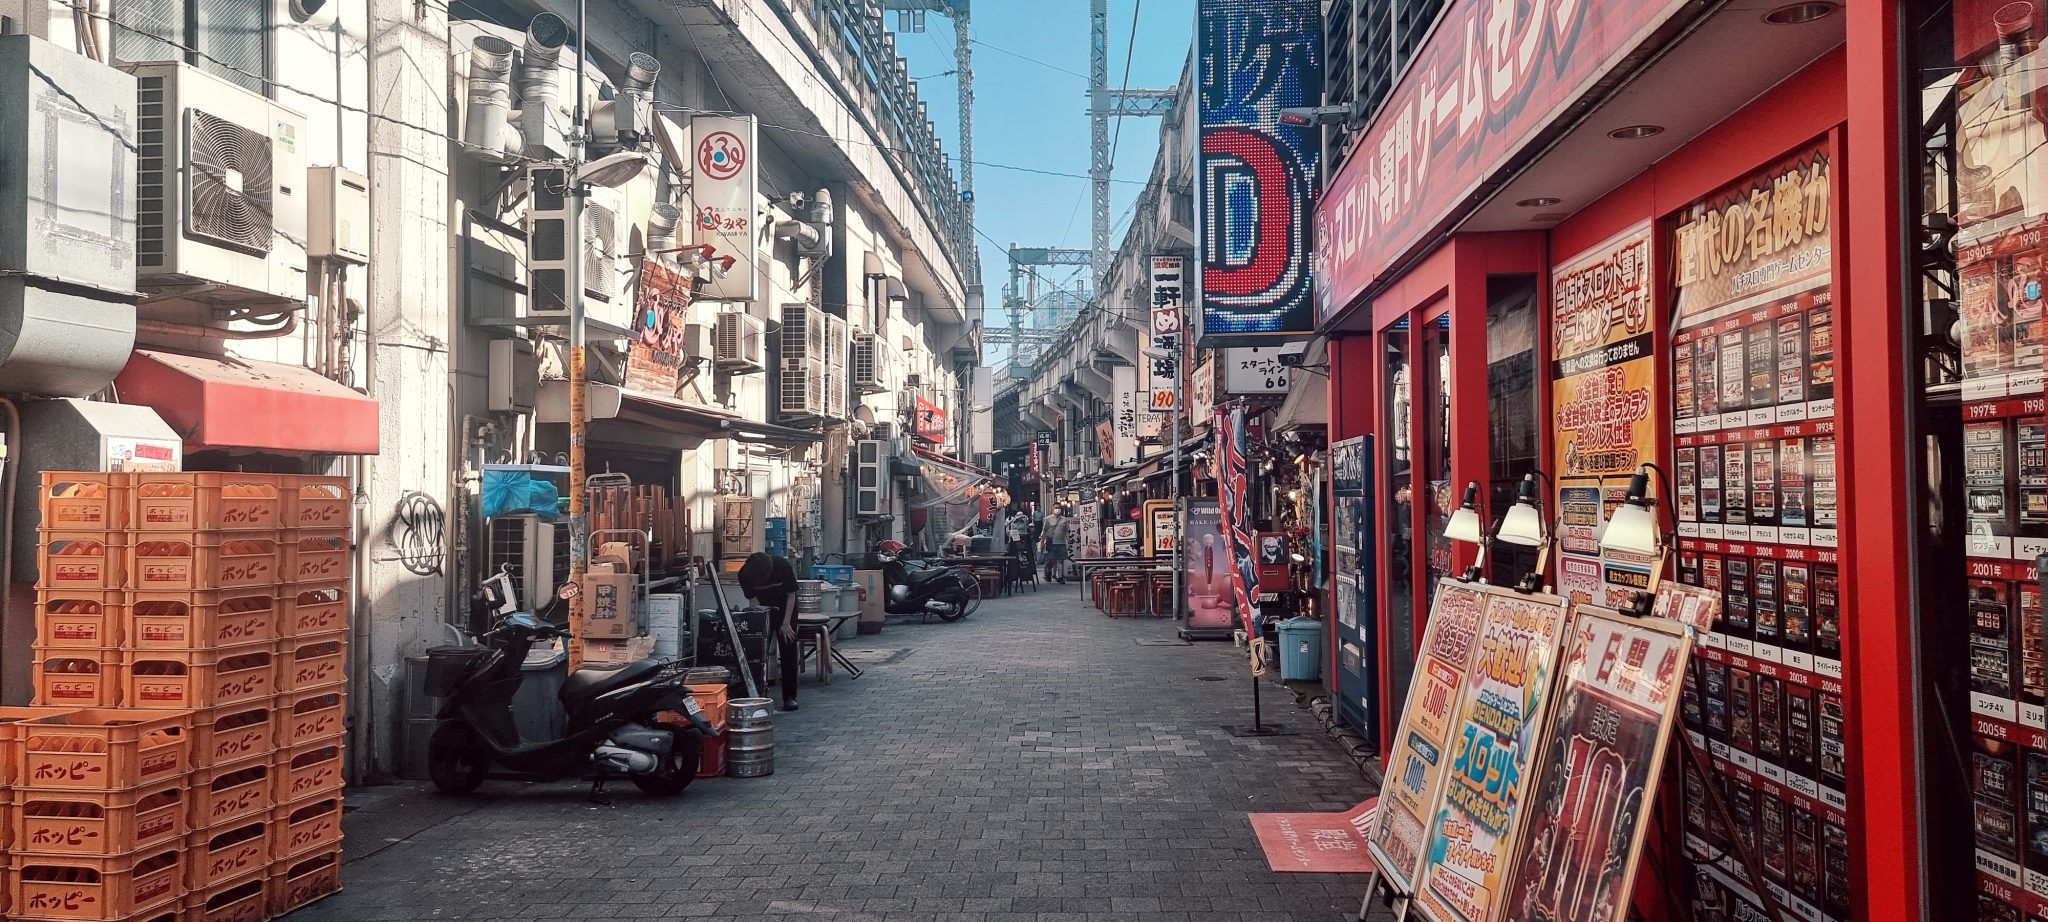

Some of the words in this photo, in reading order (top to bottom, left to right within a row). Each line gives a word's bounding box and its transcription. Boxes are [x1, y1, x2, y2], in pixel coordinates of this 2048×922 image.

[1966, 245, 1994, 262] 1990年
[1556, 240, 1648, 318] 当店はスロット専門
[1813, 292, 1832, 306] 1989年
[1781, 302, 1798, 314] 1989年
[1556, 286, 1650, 357] ゲームセンターです
[1241, 358, 1275, 370] スタート
[1259, 366, 1285, 376] ライン
[1969, 403, 1997, 419] 1997年
[1577, 420, 1632, 450] コインレス仕様
[1783, 426, 1801, 436] 1992年
[1815, 422, 1834, 433] 1993年
[148, 507, 187, 515] ホッピー
[223, 505, 270, 524] ホッピー
[300, 505, 340, 521] ホッピー
[1200, 507, 1215, 515] Wild
[1729, 544, 1745, 554] 2000年
[1756, 546, 1773, 556] 2000年
[1785, 549, 1804, 559] 2000年
[1818, 551, 1837, 562] 2001年
[58, 565, 98, 573] ホッピー
[221, 561, 268, 582] ホッピー
[300, 558, 339, 576] ホッピー
[1973, 563, 2002, 576] 2001年
[297, 609, 337, 629] ホッピー
[219, 618, 266, 640] ホッピー
[1477, 626, 1535, 688] 大歓迎!
[296, 663, 335, 684] ホッピー
[1759, 664, 1777, 676] 2003年
[1789, 671, 1808, 685] 2003年
[218, 675, 264, 698] ホッピー
[1821, 680, 1841, 694] 2004年
[1978, 699, 2005, 714] コンチ4X
[294, 715, 334, 738] ホッピー
[1978, 722, 2007, 739] 2005年
[215, 732, 262, 757] ホッピー
[142, 753, 176, 764] ホッピー
[1453, 719, 1520, 811] スロット
[35, 761, 102, 780] ホッピー
[292, 768, 332, 793] ホッピー
[213, 789, 260, 817] ホッピー
[1446, 776, 1510, 832] はじめてみませんか?
[1793, 795, 1811, 810] 2011年
[139, 816, 173, 828] ホッピー
[1826, 810, 1846, 826] 2011年
[32, 827, 98, 846] ホッピー
[290, 821, 331, 849] ホッピー
[210, 847, 258, 877] ホッピー
[136, 877, 170, 889] ホッピー
[1983, 880, 2012, 900] 2014年
[29, 891, 96, 910] ホッピー
